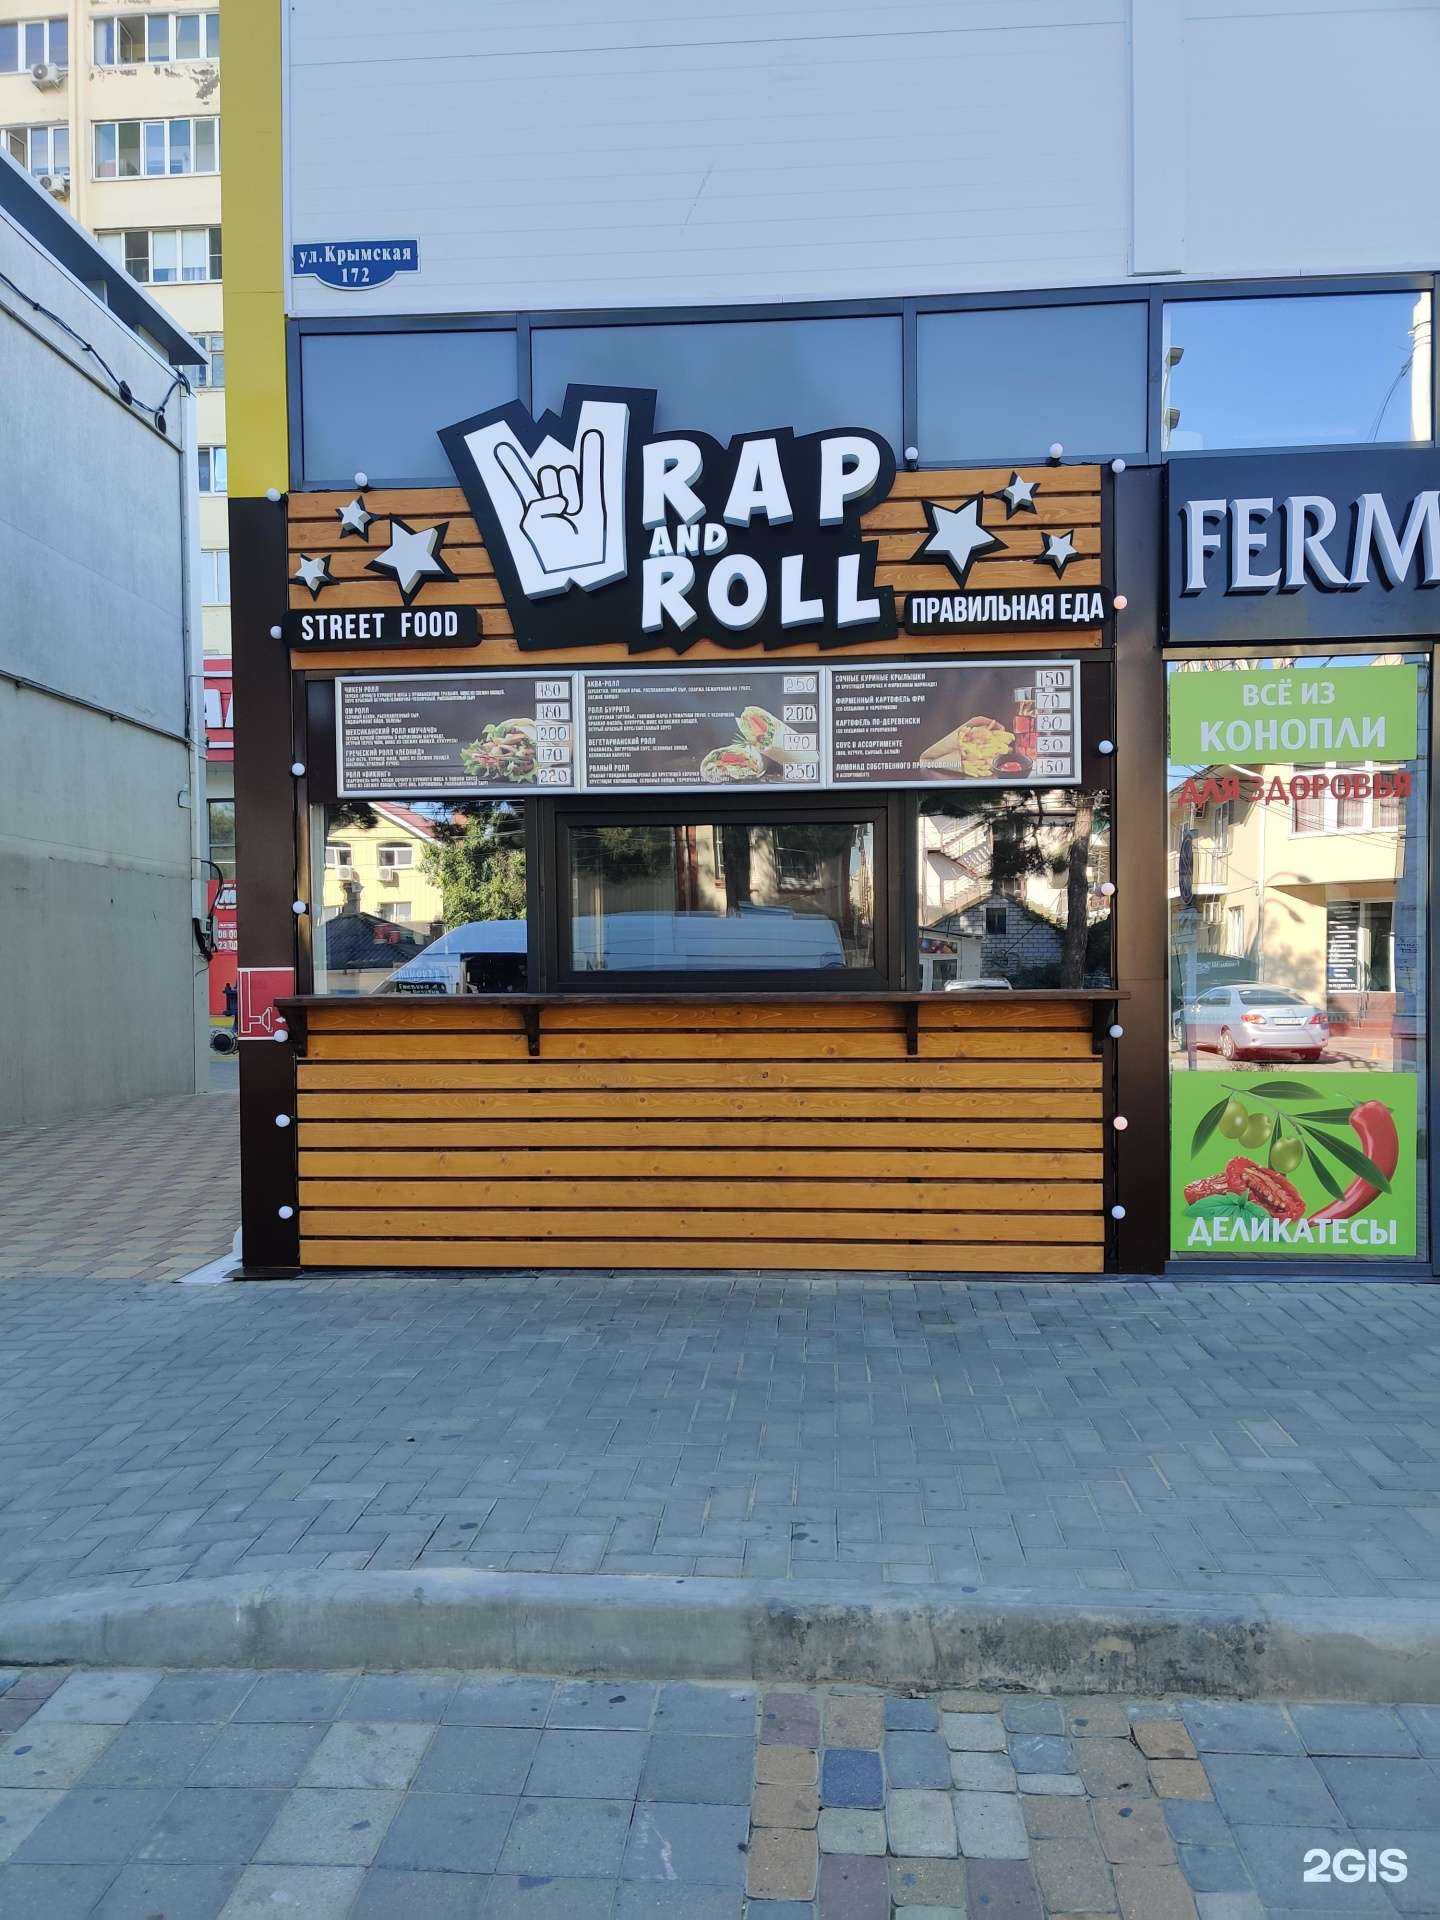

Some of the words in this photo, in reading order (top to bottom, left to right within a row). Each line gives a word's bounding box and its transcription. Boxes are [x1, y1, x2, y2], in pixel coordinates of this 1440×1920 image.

[341, 267, 370, 283] 172
[648, 523, 728, 556] AND
[1183, 490, 1440, 592] FERM
[642, 553, 881, 632] ROLL
[912, 594, 1054, 624] ПРАВИЛЬНАЯ
[1060, 592, 1105, 622] ЕДА
[301, 613, 385, 640] STREET
[401, 611, 458, 637] FOOD
[891, 673, 925, 681] КРЫЛЫШКИ
[1040, 672, 1064, 686] 150
[1243, 679, 1293, 706] ВСЁ
[1301, 682, 1336, 704] ИЗ
[836, 696, 874, 704] ФИРМЕННЫЙ
[1042, 694, 1059, 708] 70
[605, 705, 630, 713] БУРРИТО
[786, 706, 813, 720] 200
[346, 727, 389, 735] МЕКСИКАНСКИЙ
[540, 727, 566, 740] 200
[1200, 716, 1385, 752] КОНОПЛИ
[589, 737, 639, 745] ВЕГЕТАРИАНСКИЙ
[858, 740, 903, 748] АССОРТИМЕНТЕ
[346, 748, 377, 757] ГРЕЧЕСКИЙ
[543, 748, 562, 761] 170
[589, 764, 612, 772] РВАНЫЙ
[786, 764, 814, 779] 250
[867, 762, 911, 770] СОБСТВЕННОГО
[540, 769, 567, 783] 220
[1178, 776, 1241, 807] ДЛЯ
[1252, 772, 1412, 805] ЗДОРОВЬЯ
[1187, 1216, 1397, 1247] ДЕЛИКАТЕСЫ
